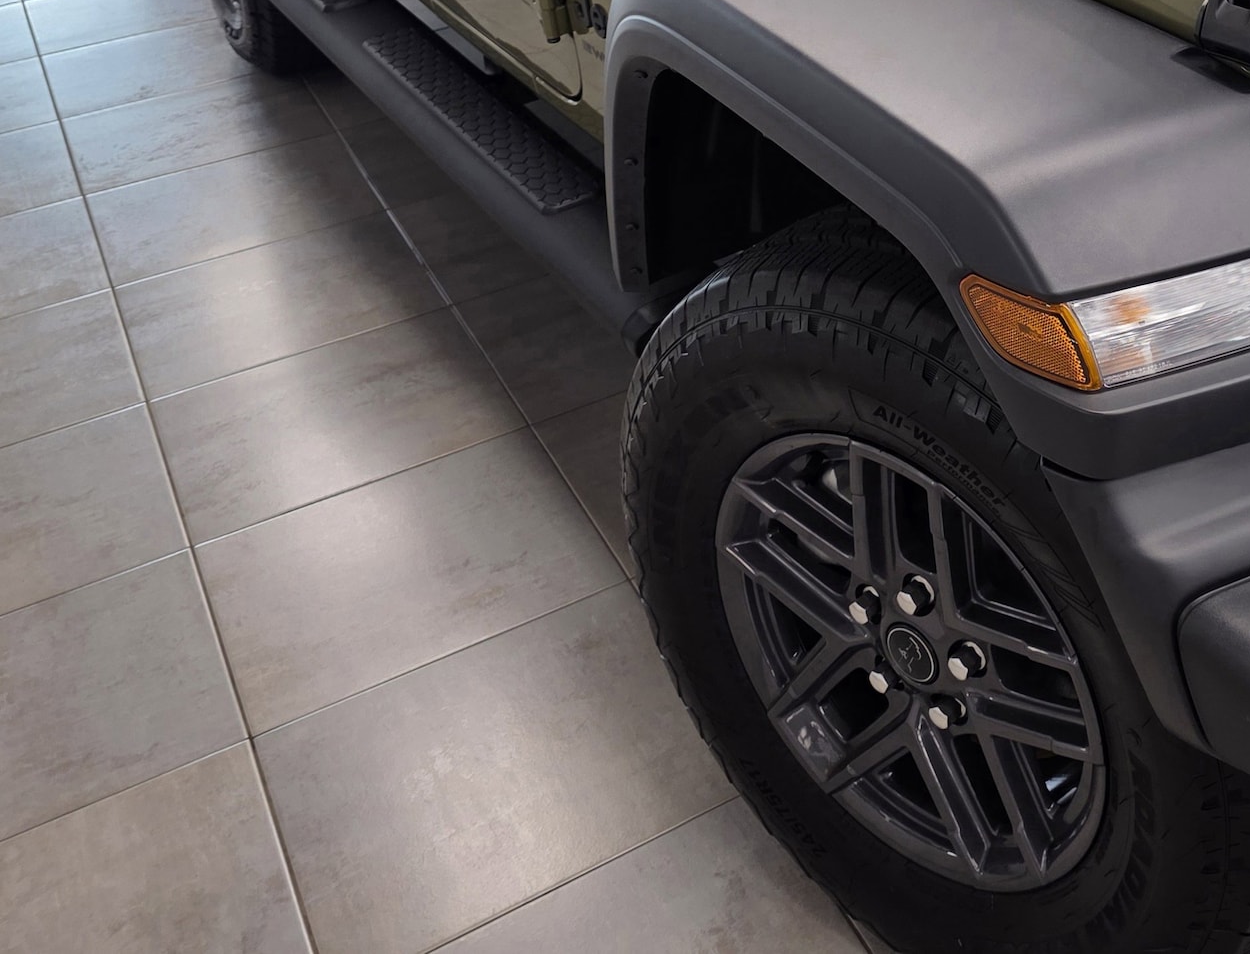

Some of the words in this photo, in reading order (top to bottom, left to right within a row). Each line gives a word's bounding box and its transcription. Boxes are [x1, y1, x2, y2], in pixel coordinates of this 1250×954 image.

[872, 403, 1007, 510] All-Weather
[926, 448, 1002, 520] Performance
[738, 756, 828, 858] 245/75R17
